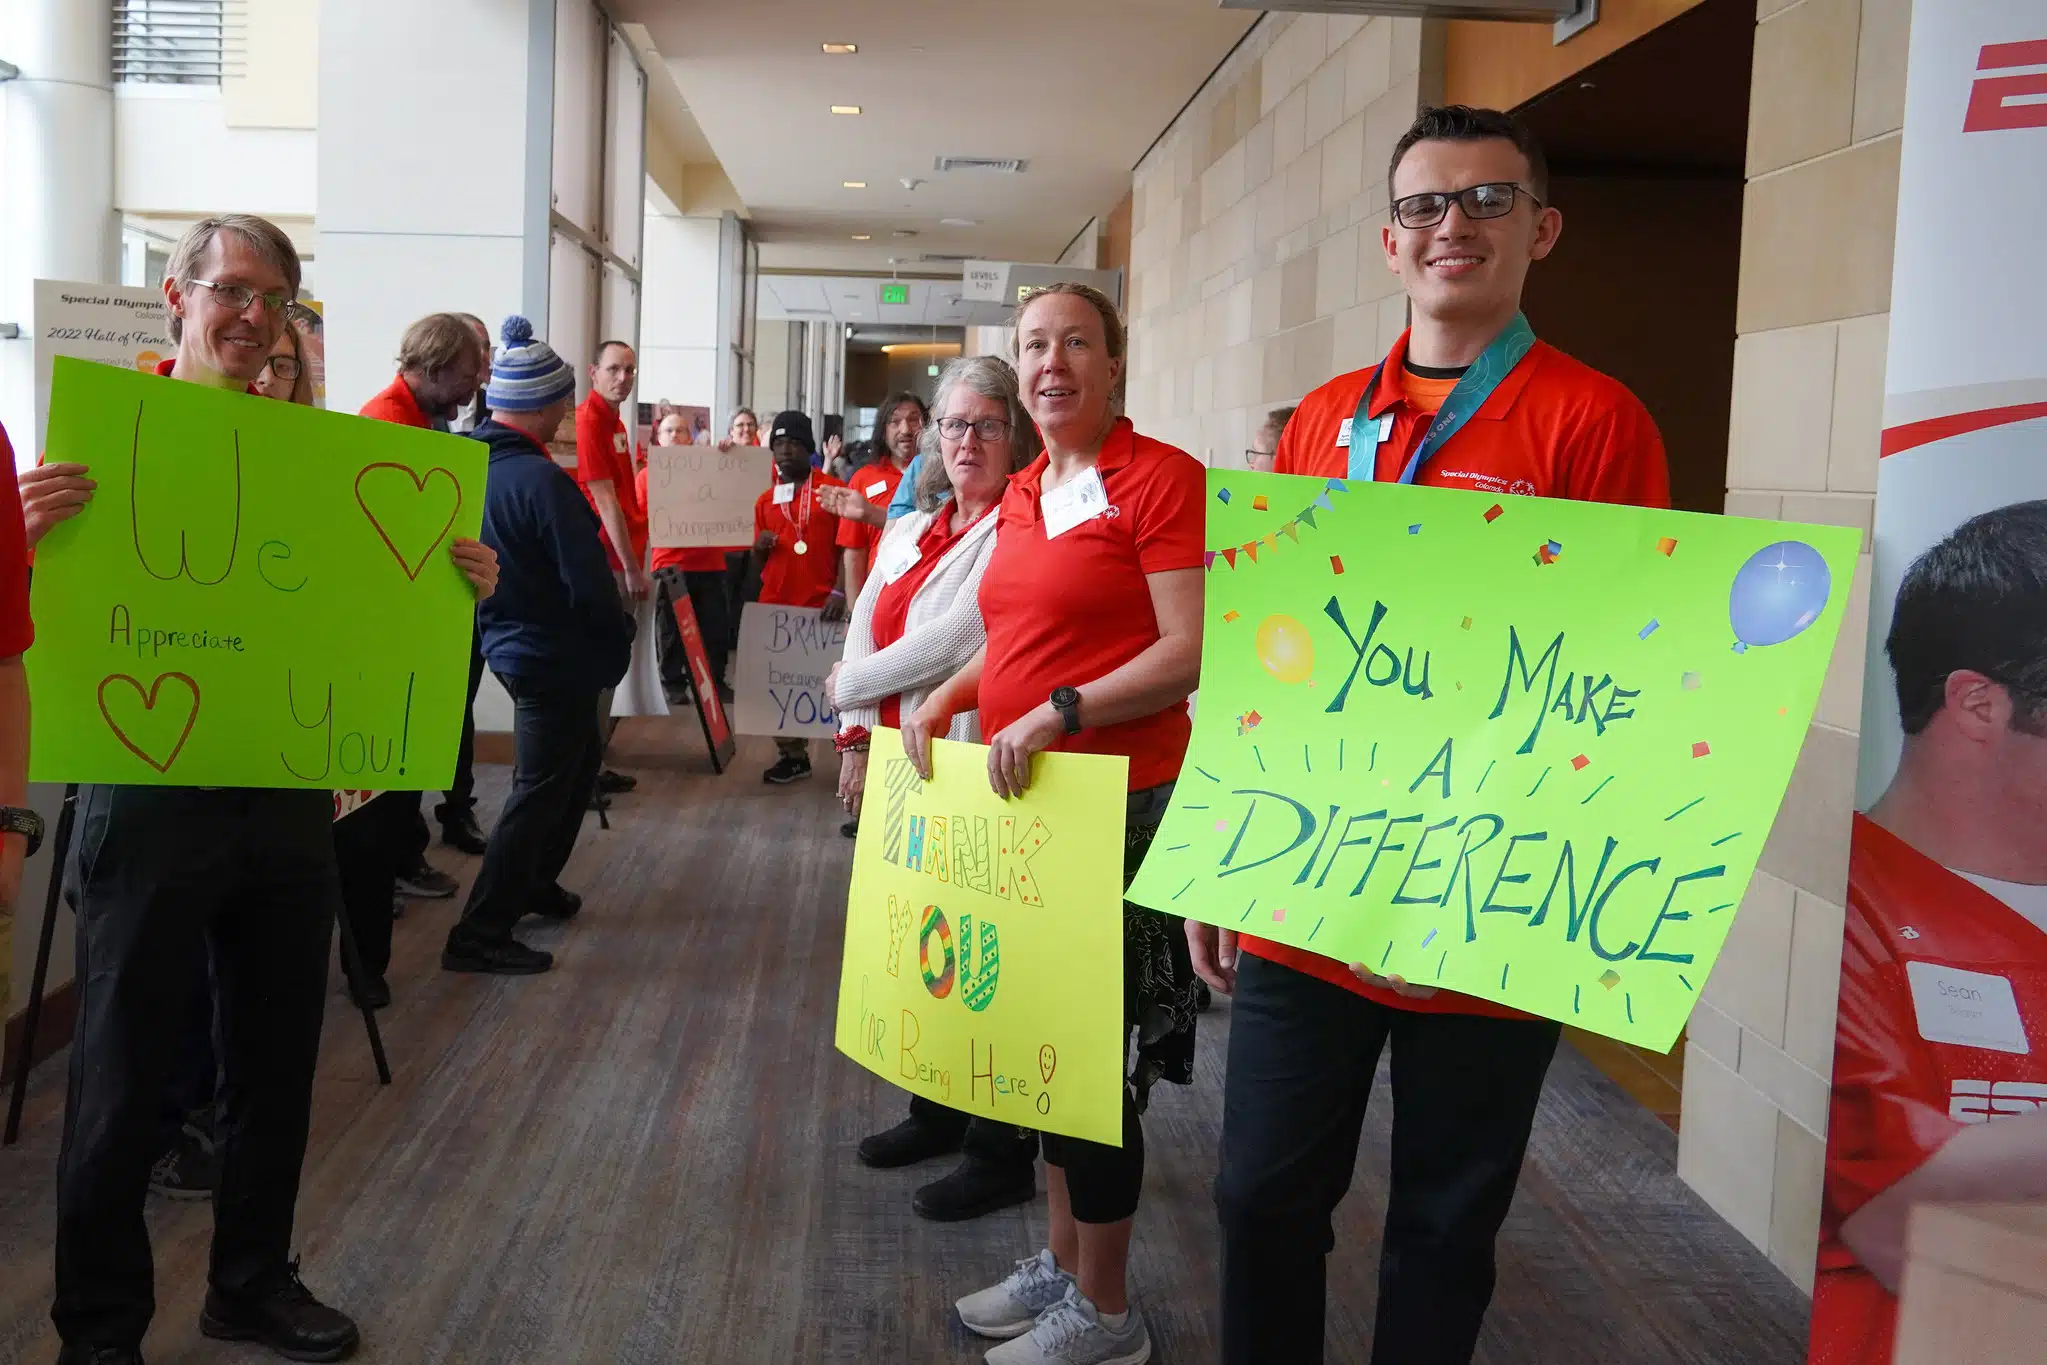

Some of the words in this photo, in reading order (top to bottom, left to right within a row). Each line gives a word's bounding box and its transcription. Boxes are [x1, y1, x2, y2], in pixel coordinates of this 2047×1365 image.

[970, 271, 998, 280] LEVELS
[60, 294, 110, 305] Special
[113, 298, 168, 310] Olympic
[47, 327, 82, 340] 2022
[83, 328, 116, 342] Hall
[117, 333, 131, 348] of
[131, 331, 167, 346] Fame
[1436, 411, 1457, 432] ONE
[698, 484, 717, 501] a
[1440, 469, 1470, 478] Special
[1469, 472, 1508, 485] Olympics
[1474, 481, 1504, 493] Colorado
[131, 400, 308, 592] We
[652, 506, 756, 545] Changemake
[109, 604, 246, 658] Appreciate
[765, 610, 845, 656] BRAVE
[768, 661, 825, 689] because
[1409, 737, 1454, 798] A
[883, 757, 1053, 908] THANK
[1217, 788, 1726, 963] DIFFERENCE
[887, 894, 1000, 1012] YOU
[1936, 980, 1982, 1002] Sean
[900, 1008, 951, 1101] Being
